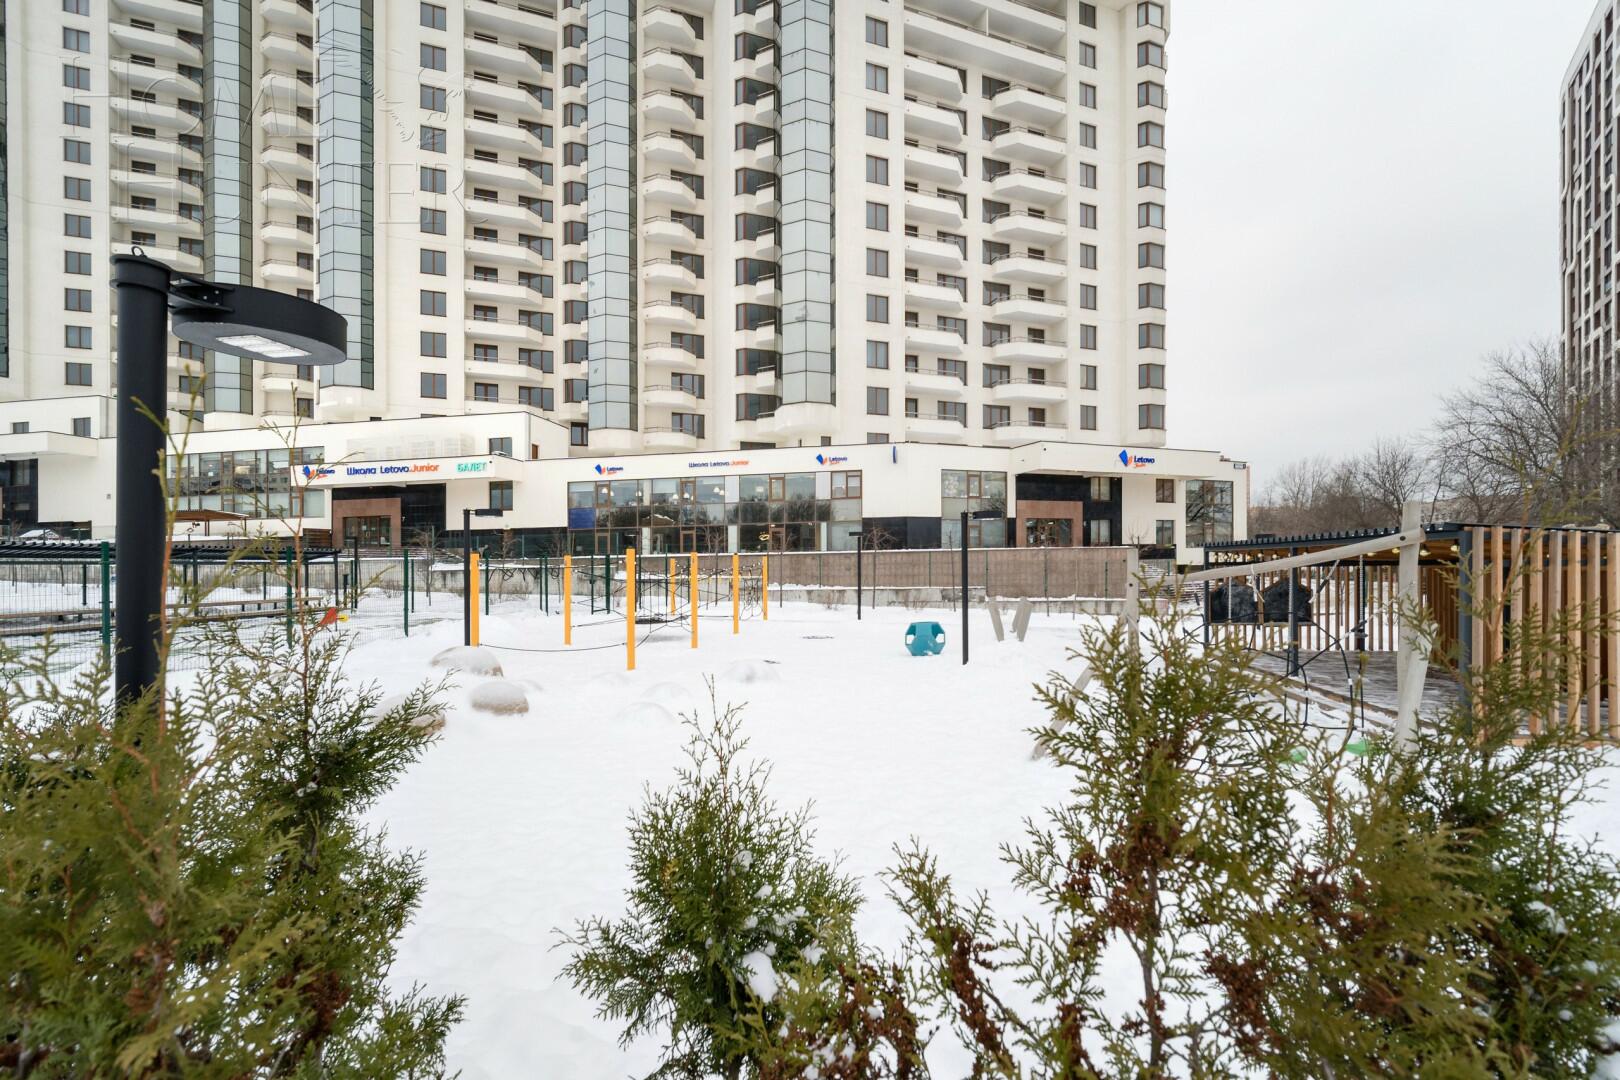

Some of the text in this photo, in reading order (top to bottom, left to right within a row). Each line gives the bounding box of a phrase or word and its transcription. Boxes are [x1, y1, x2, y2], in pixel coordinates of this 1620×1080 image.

[1134, 455, 1155, 464] Letovo
[347, 467, 377, 476] Школа
[457, 462, 487, 472] БАЛЕТ
